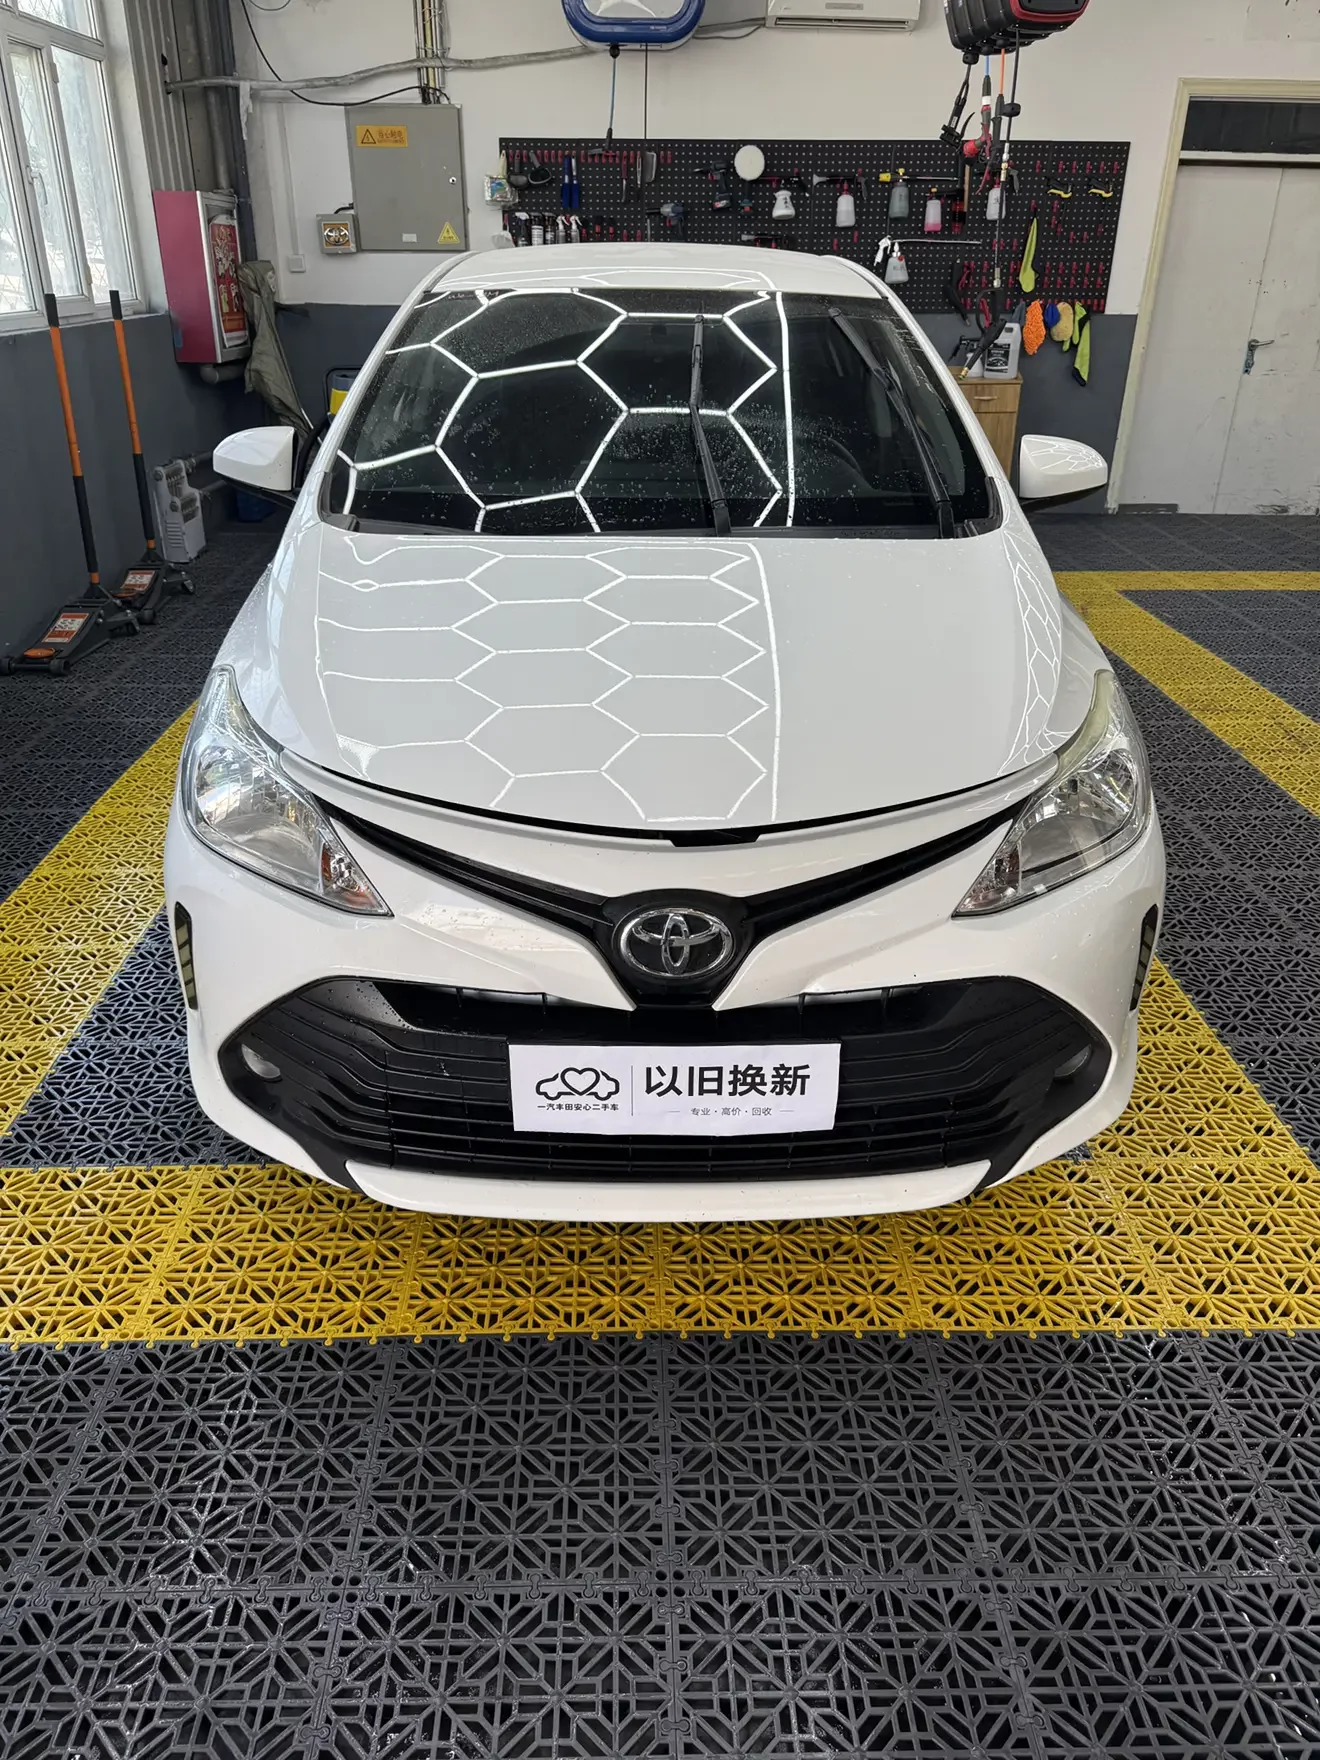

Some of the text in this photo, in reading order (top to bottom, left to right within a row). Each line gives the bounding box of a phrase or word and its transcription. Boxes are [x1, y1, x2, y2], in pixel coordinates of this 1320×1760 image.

[645, 1063, 811, 1098] 以旧换新
[537, 1102, 619, 1111] 一汽丰田安心二手车
